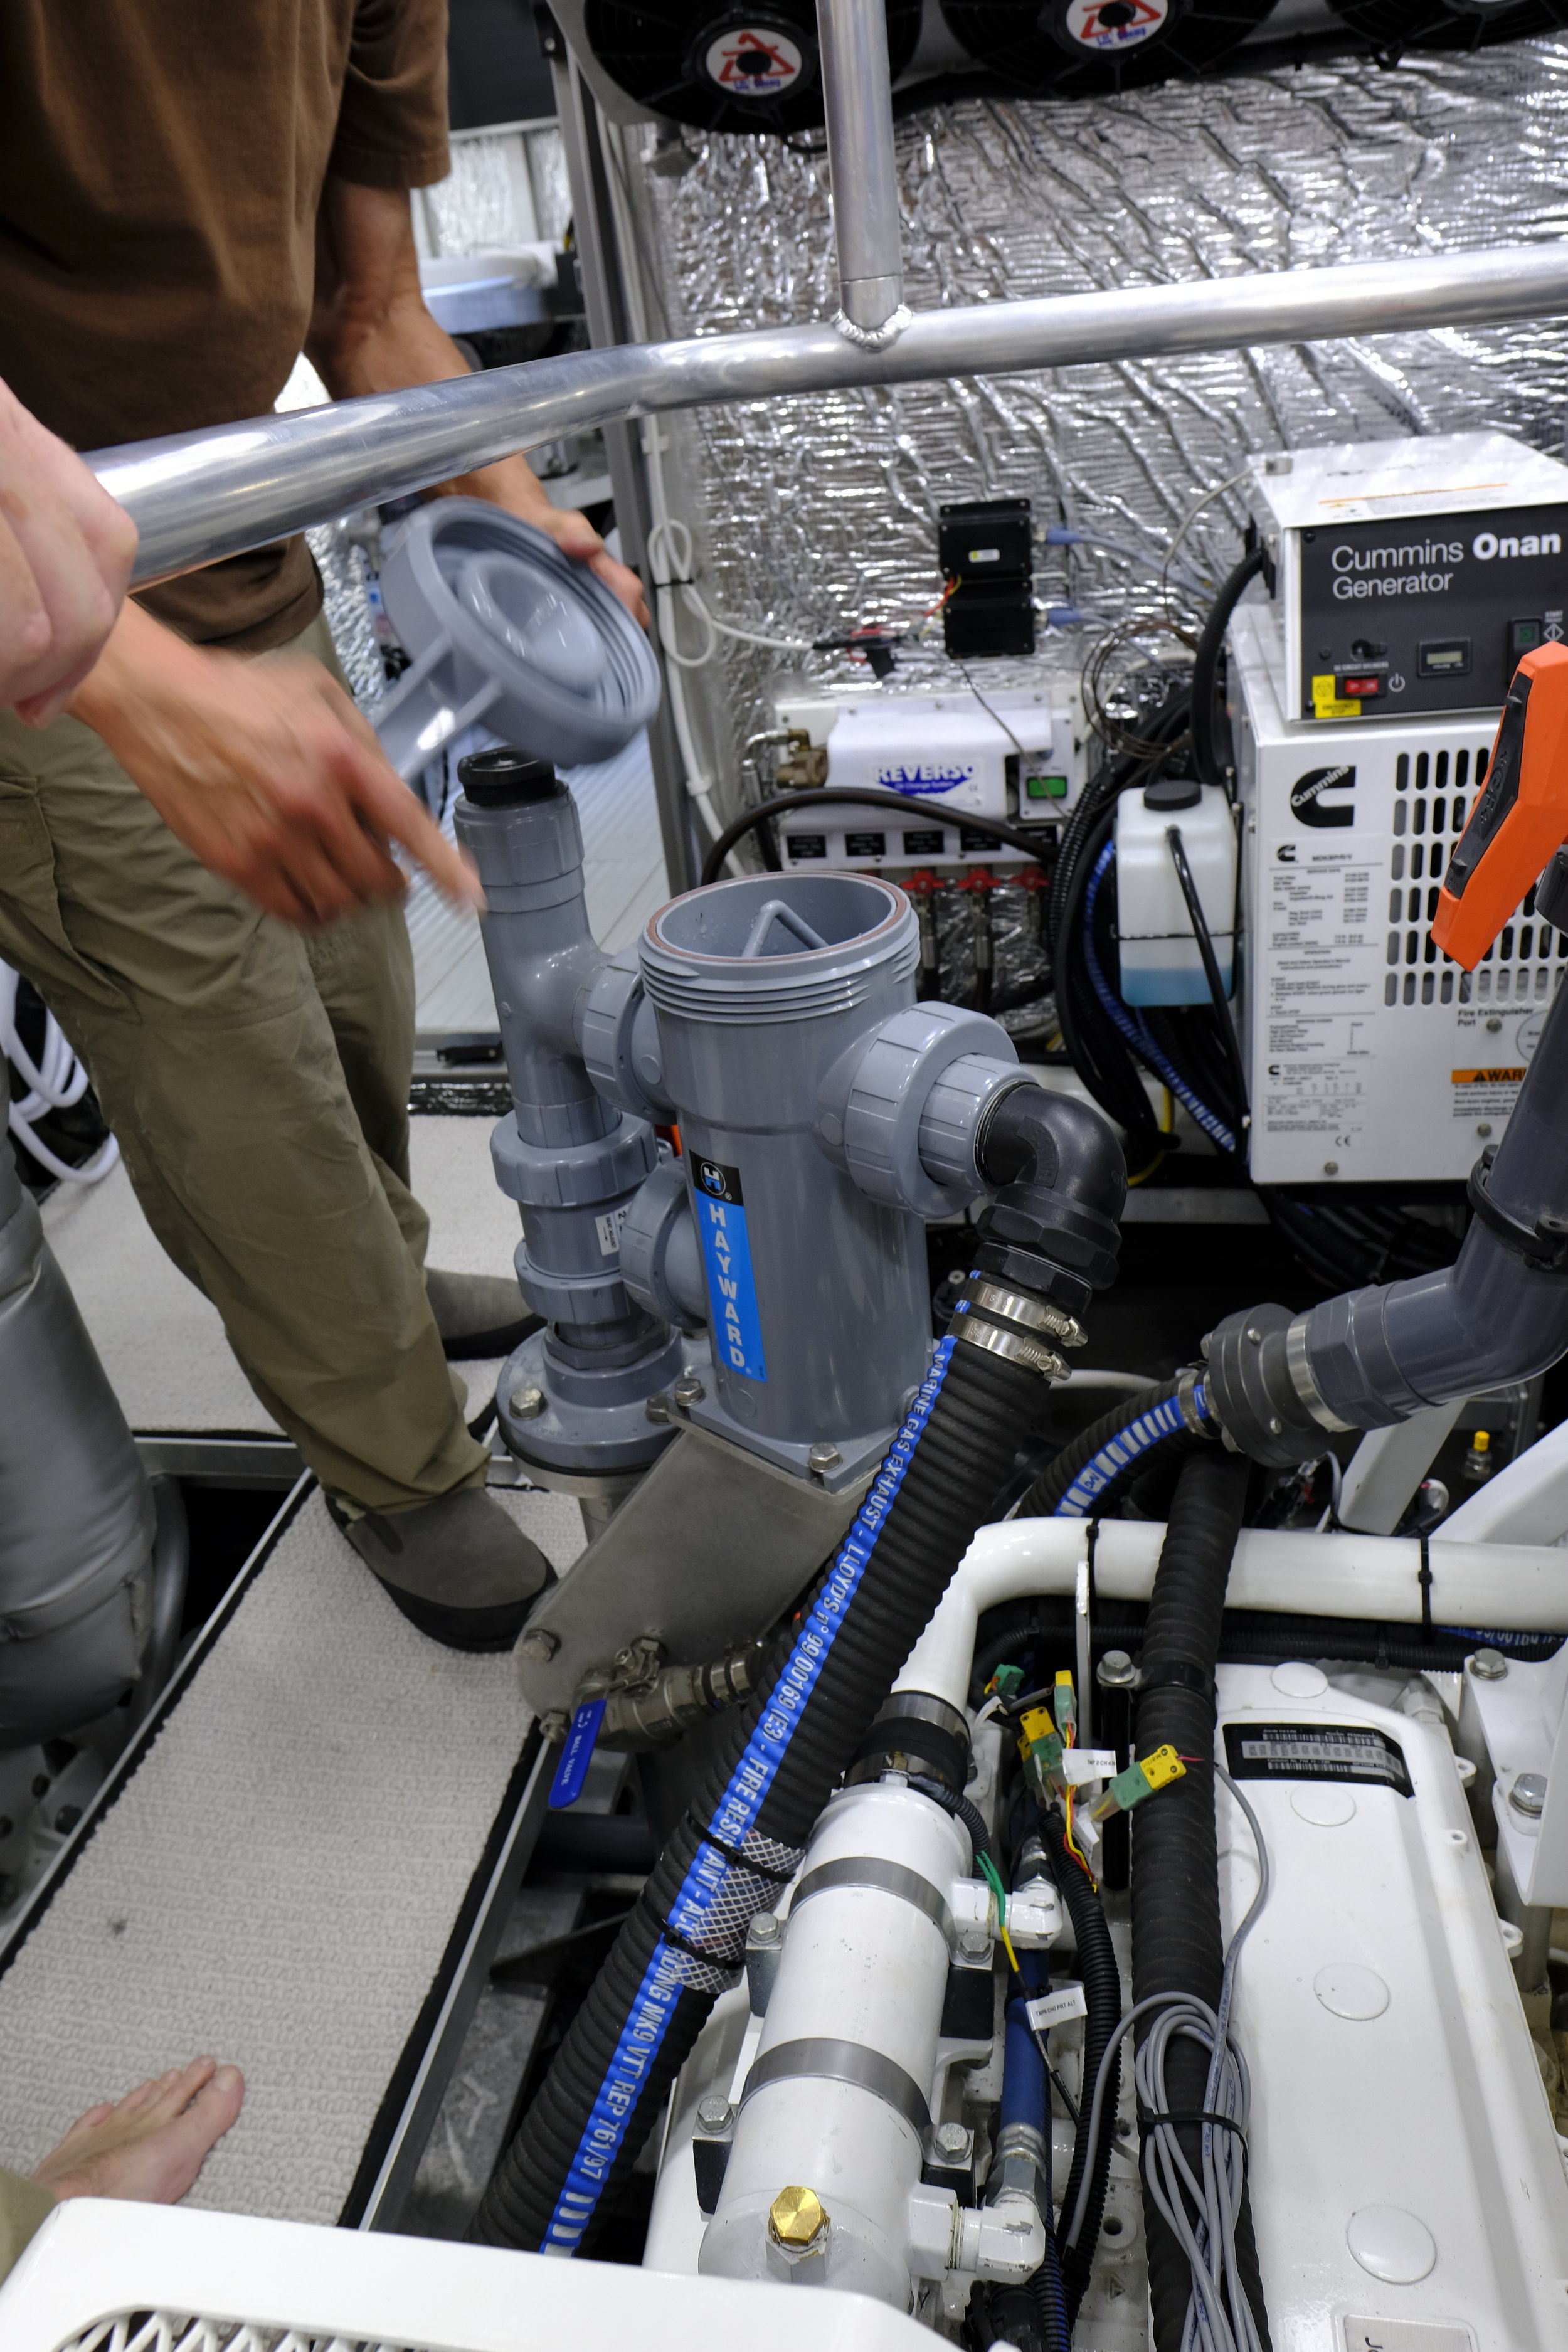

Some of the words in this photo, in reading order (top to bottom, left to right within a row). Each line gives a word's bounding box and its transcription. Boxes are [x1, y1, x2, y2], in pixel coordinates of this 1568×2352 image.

[1331, 538, 1464, 573] Cummins
[1471, 532, 1562, 561] Onan
[1332, 571, 1454, 600] Generator
[876, 763, 977, 783] REVERSO
[1291, 765, 1350, 807] Cummins
[1478, 1007, 1533, 1016] Extinguisher
[1488, 1068, 1527, 1081] WAR
[709, 1202, 745, 1368] HAYWARD
[909, 1354, 945, 1415] MARINE
[897, 1418, 919, 1451] GAS
[862, 1454, 903, 1530] EXHAUST
[824, 1544, 864, 1613] LLOYD'S
[778, 1633, 823, 1710] 99/00169
[763, 1709, 789, 1742] (E3)
[569, 1734, 581, 1756] BALL
[561, 1757, 575, 1786] VALVE
[735, 1757, 768, 1801] FIRE
[649, 1899, 704, 2001] ACCRDING
[633, 2001, 665, 2042] MK9
[1057, 2001, 1066, 2010] PRT
[620, 2046, 650, 2079] VTT
[607, 2080, 635, 2116] REP
[581, 2119, 620, 2179] 761/97
